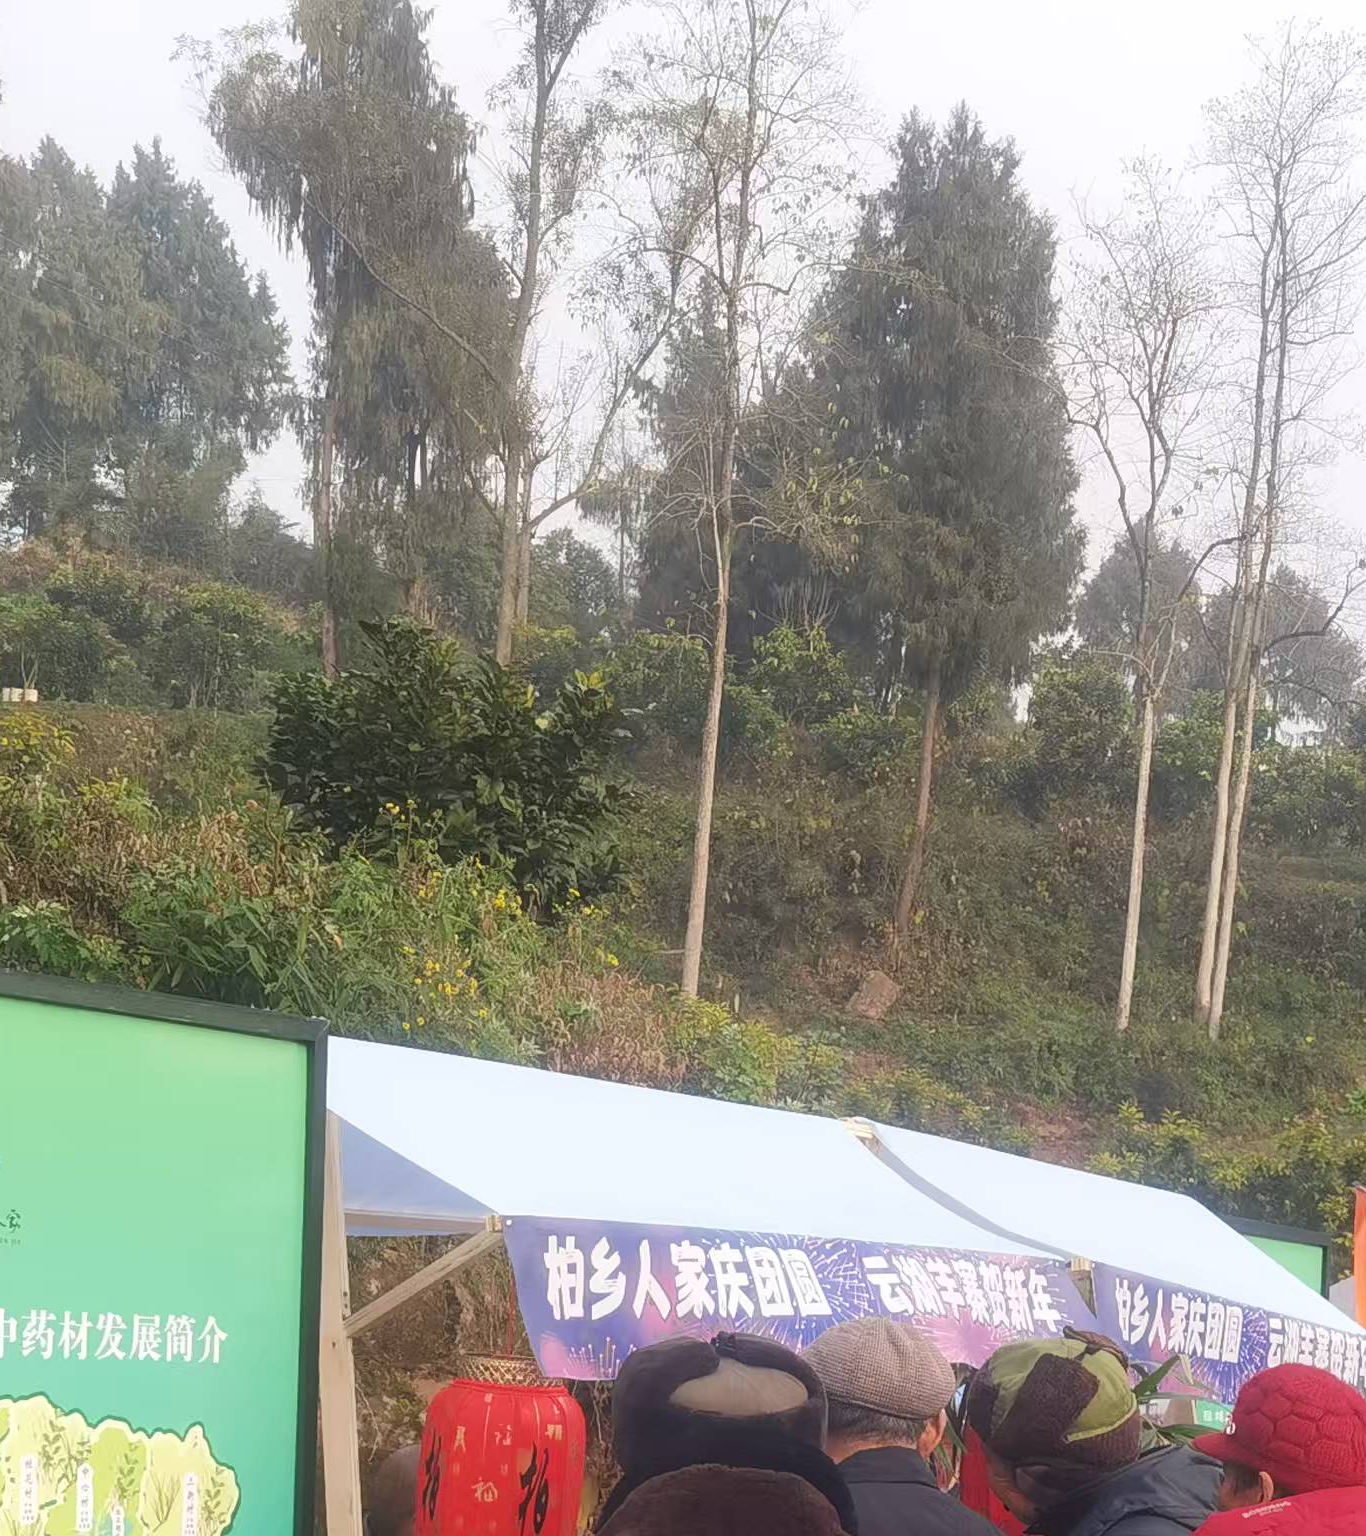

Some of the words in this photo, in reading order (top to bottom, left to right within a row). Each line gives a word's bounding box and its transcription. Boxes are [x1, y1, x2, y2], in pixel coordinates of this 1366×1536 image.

[543, 1234, 833, 1321] 柏乡人家庆团圆
[861, 1254, 1065, 1334] 云湖羊寨贺新年
